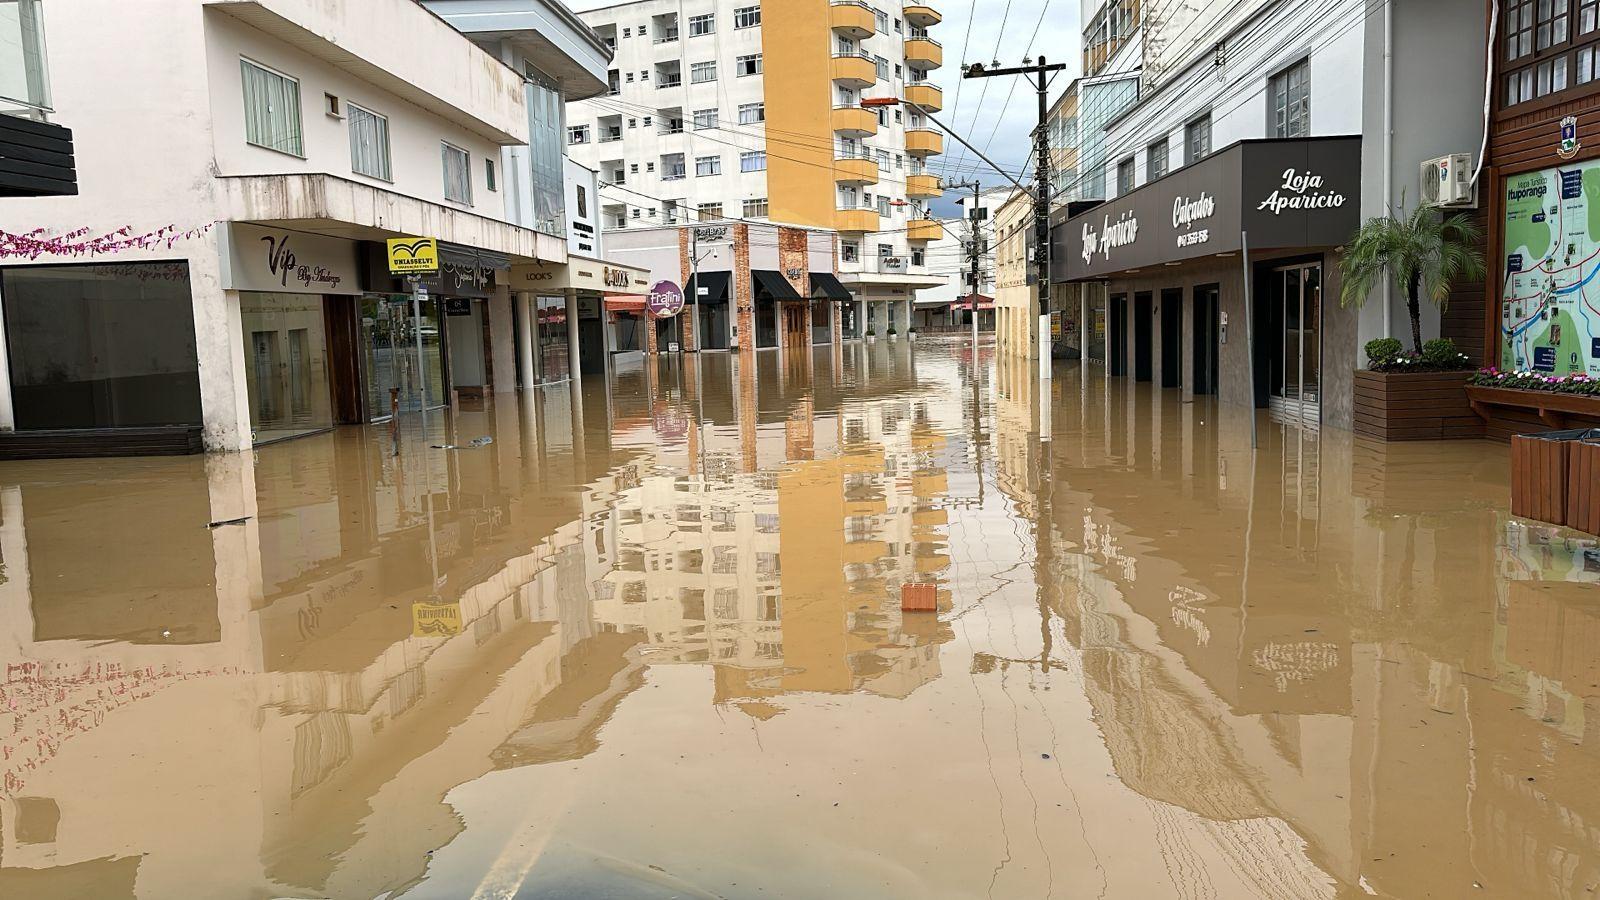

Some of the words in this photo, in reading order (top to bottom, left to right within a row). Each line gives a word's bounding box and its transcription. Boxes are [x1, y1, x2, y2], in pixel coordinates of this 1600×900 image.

[1281, 168, 1323, 192] Loja
[1257, 190, 1346, 214] Aparicio
[1508, 185, 1547, 201] Ituporanga
[1172, 191, 1215, 230] Calçados
[1081, 222, 1097, 265] Loja
[261, 235, 296, 287] Vip
[526, 272, 552, 281] LOOK'S
[650, 291, 681, 307] Fratini
